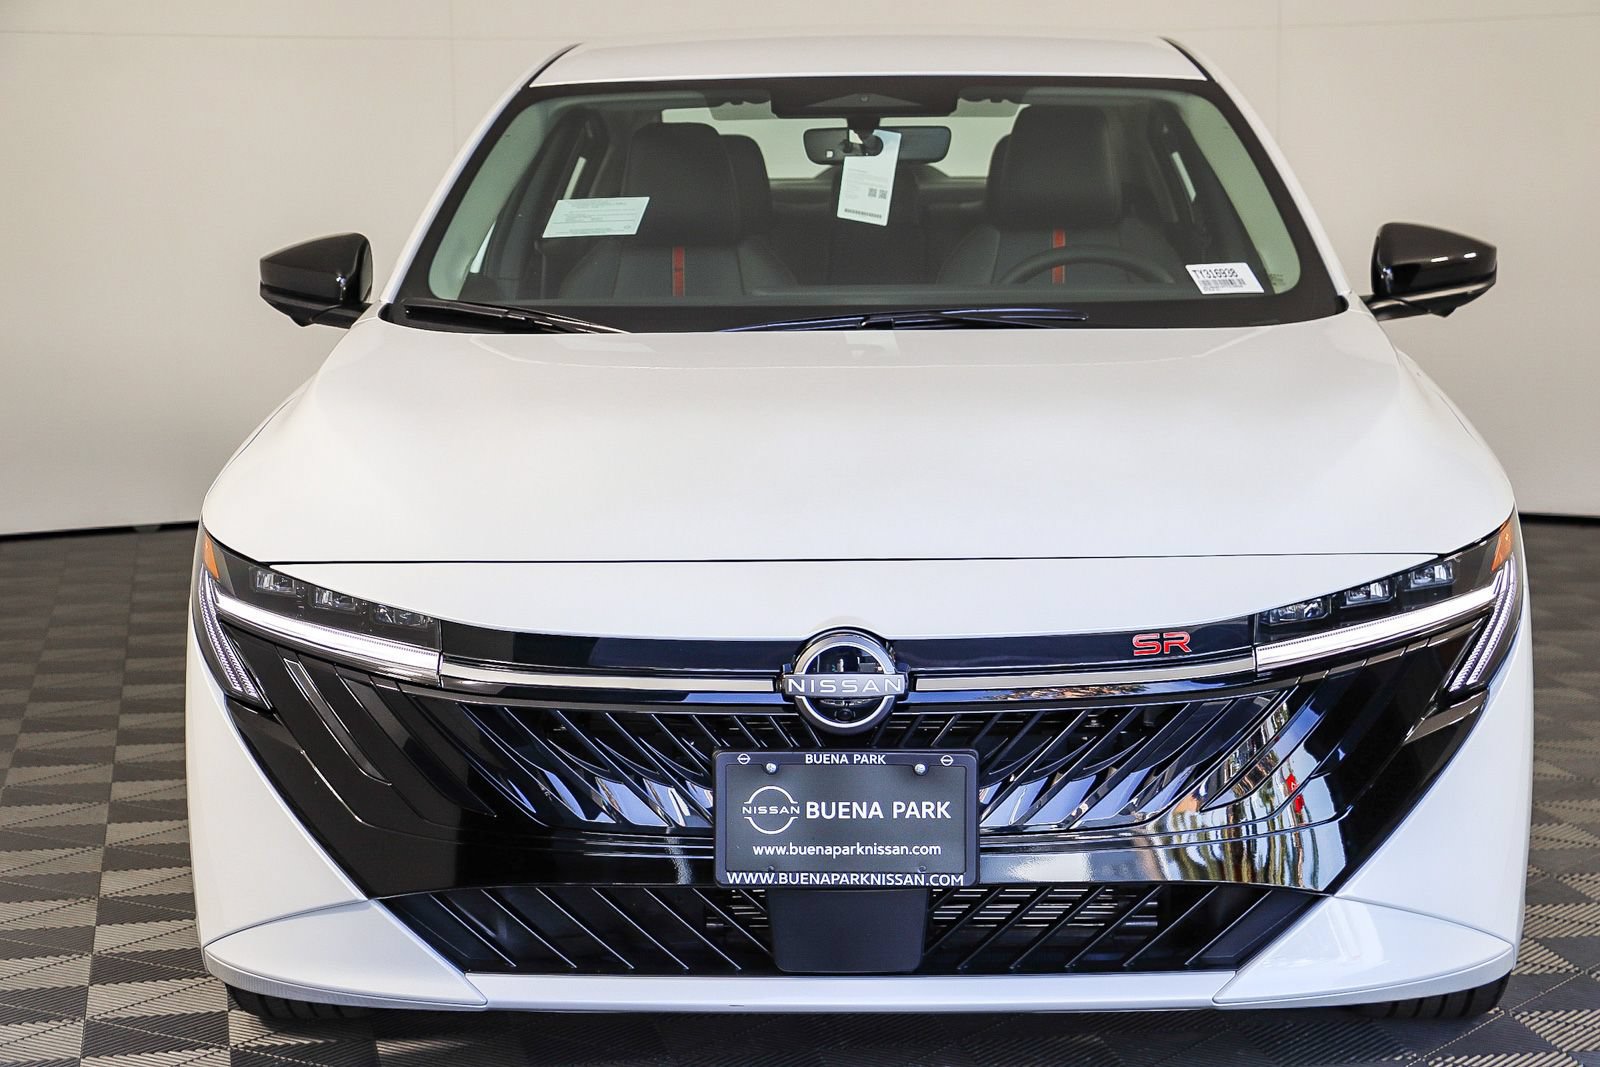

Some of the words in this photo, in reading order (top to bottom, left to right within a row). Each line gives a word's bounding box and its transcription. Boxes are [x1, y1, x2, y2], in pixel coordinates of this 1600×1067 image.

[1132, 631, 1192, 656] SR
[787, 678, 902, 693] NISSAN
[805, 753, 849, 765] BUENA
[853, 754, 887, 765] PARK
[742, 805, 800, 815] NISSAN
[805, 801, 884, 820] BUENA
[892, 801, 952, 820] PARK
[752, 842, 942, 859] www.buenaparknissan.com
[726, 872, 965, 887] WWW.BUENAPARKNISSAN.COM
